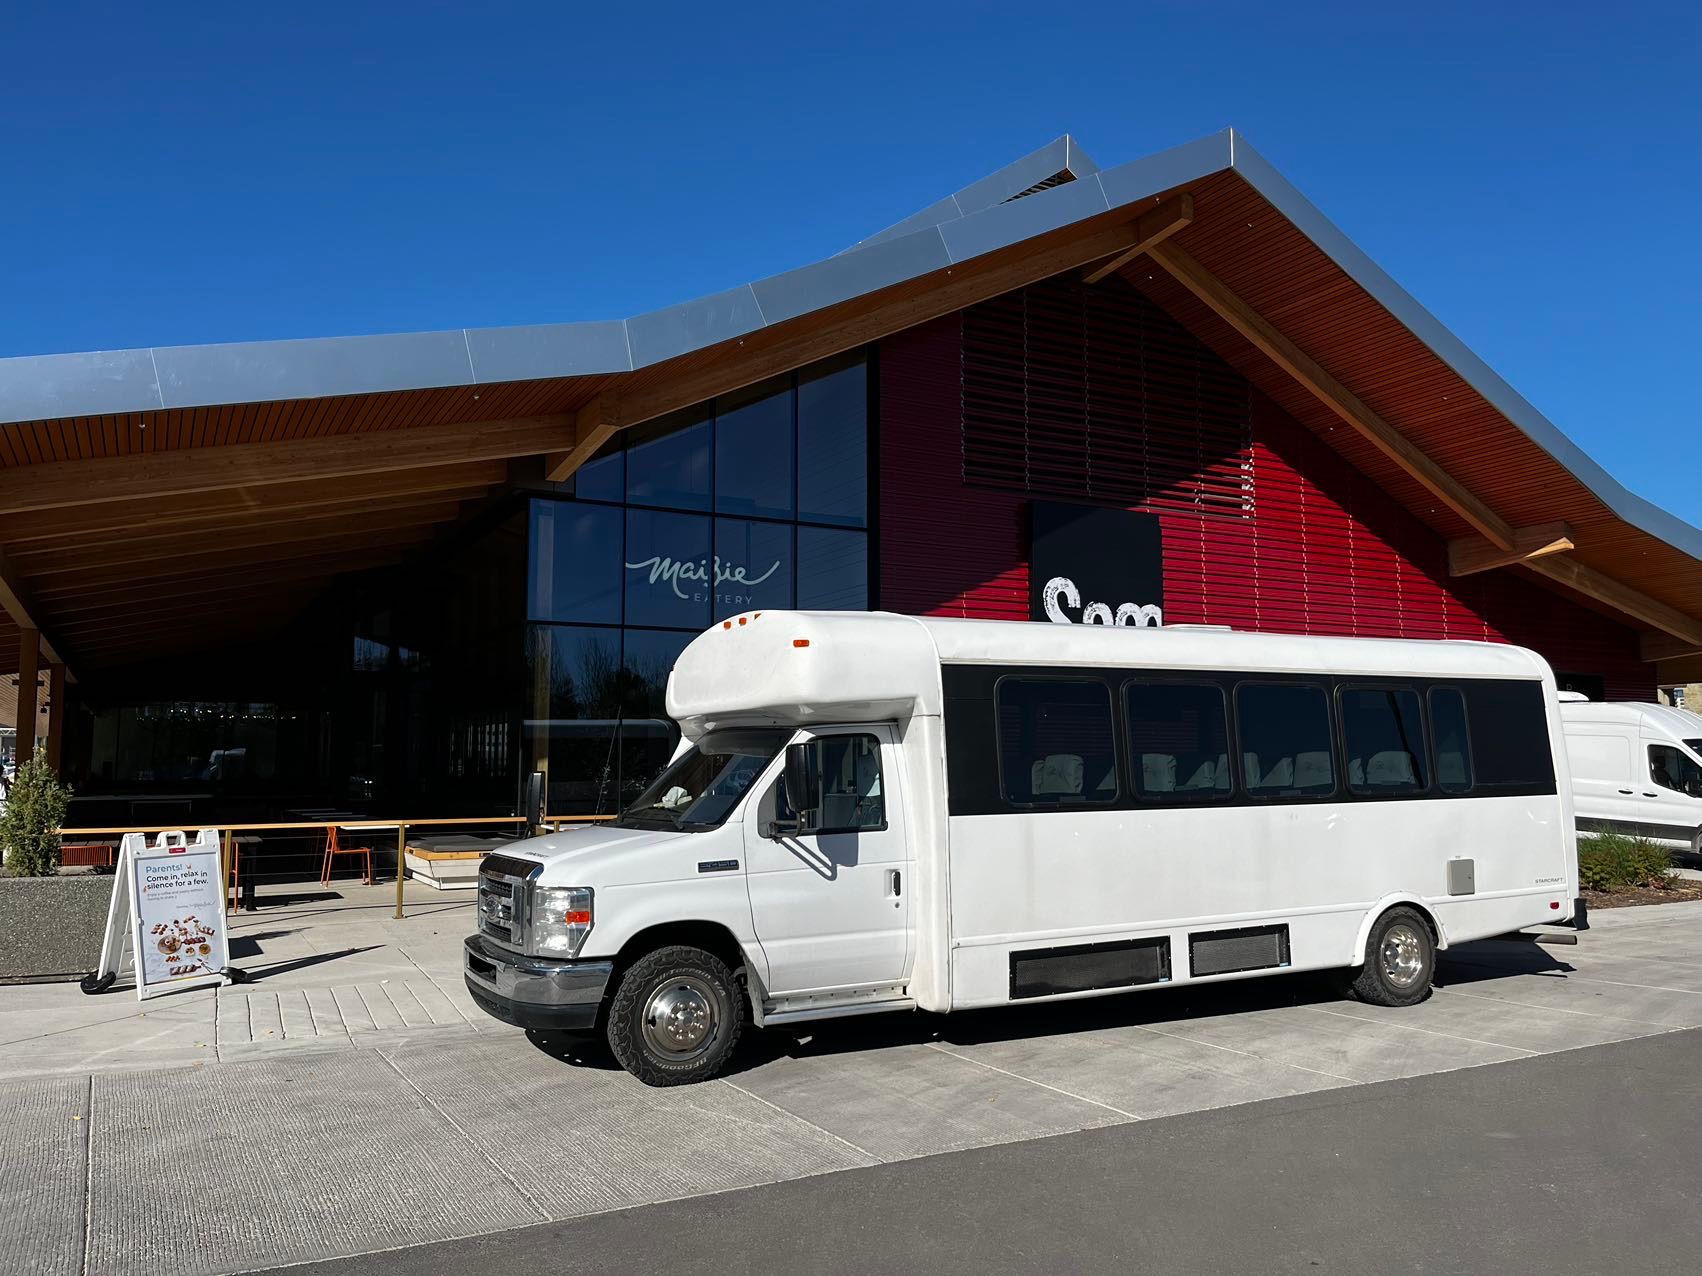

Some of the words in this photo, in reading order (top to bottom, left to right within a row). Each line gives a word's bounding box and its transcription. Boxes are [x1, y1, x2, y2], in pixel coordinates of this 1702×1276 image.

[694, 593, 752, 605] ETERY
[146, 864, 183, 873] Parents!
[147, 882, 174, 890] silence
